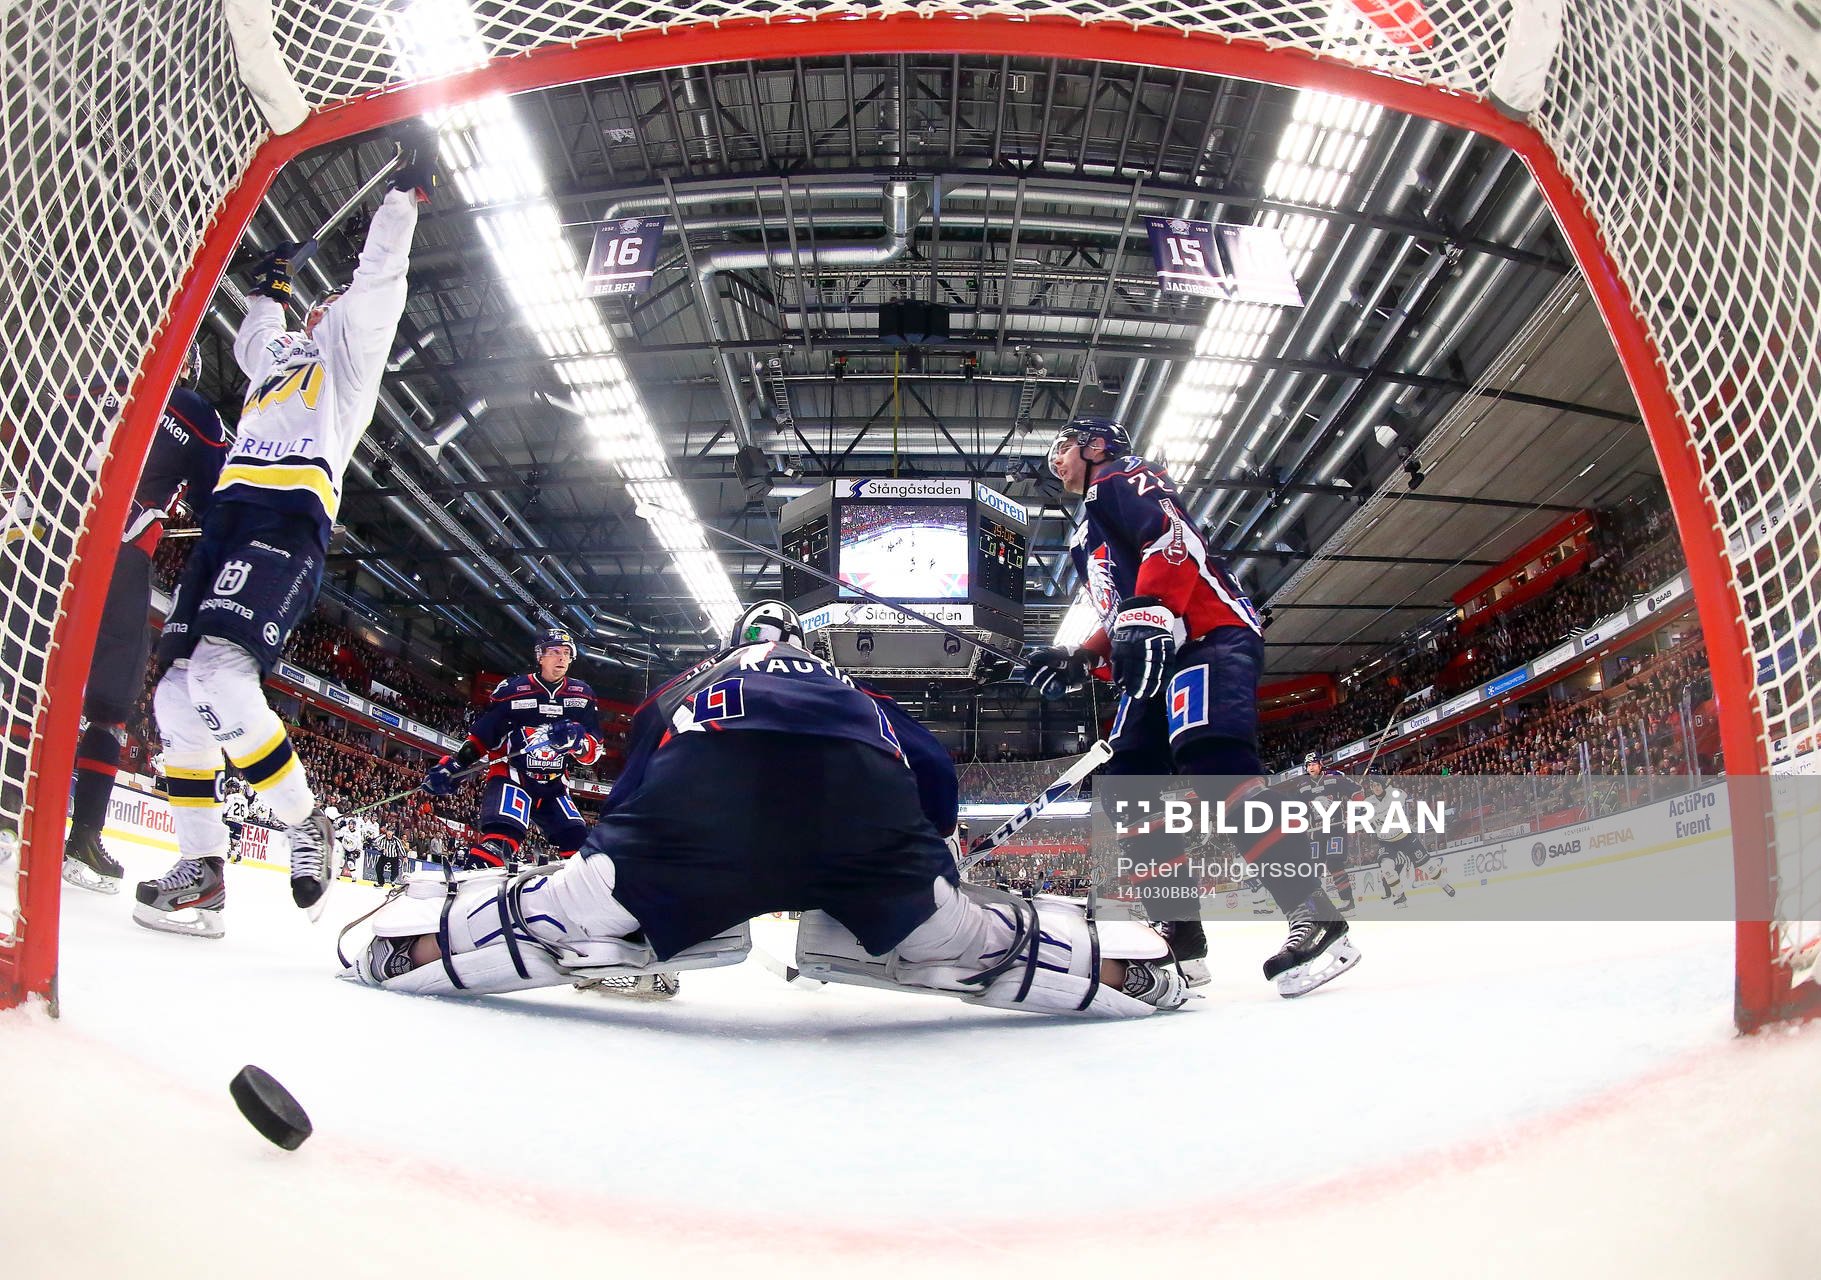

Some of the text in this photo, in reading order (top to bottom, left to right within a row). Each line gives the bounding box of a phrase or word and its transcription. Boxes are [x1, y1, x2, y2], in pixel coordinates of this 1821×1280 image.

[603, 237, 642, 267] 16
[1166, 237, 1204, 268] 15
[593, 282, 636, 294] HELBER
[868, 481, 962, 499] Stångåstaden
[978, 487, 1026, 524] Corren
[1656, 590, 1672, 604] SAAB
[1119, 611, 1167, 627] Reebok
[1410, 716, 1429, 728] Corren
[233, 802, 245, 818] 26
[1669, 792, 1715, 818] ActiPro
[241, 823, 269, 845] TEAM
[1675, 814, 1711, 838] Event
[1548, 827, 1634, 858] SAAB ARENA
[1475, 845, 1508, 874] east
